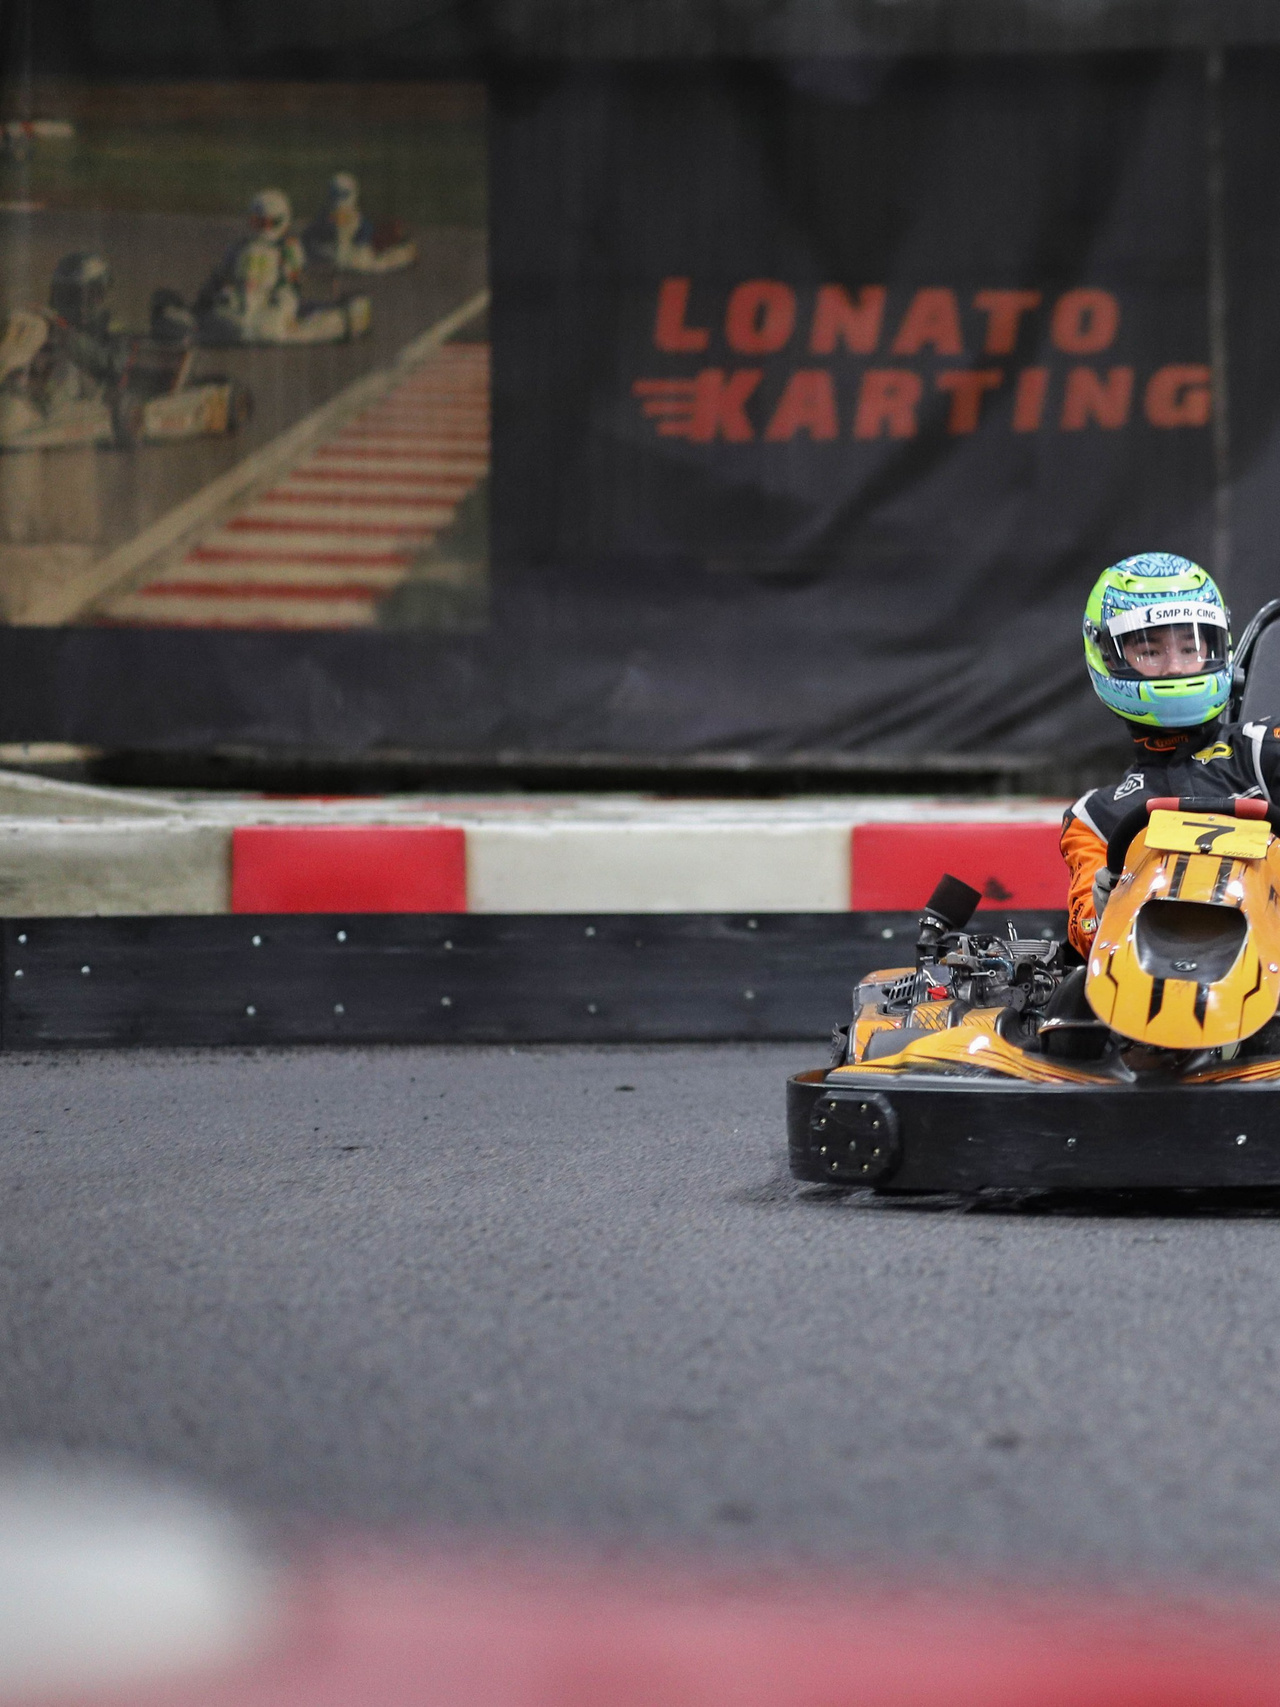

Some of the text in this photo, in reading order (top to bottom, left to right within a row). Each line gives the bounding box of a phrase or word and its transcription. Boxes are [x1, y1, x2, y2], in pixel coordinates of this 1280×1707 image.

[654, 279, 1119, 355] LONATO
[680, 365, 1211, 442] KARTING
[1156, 609, 1180, 620] SMP
[1182, 821, 1236, 854] 7
